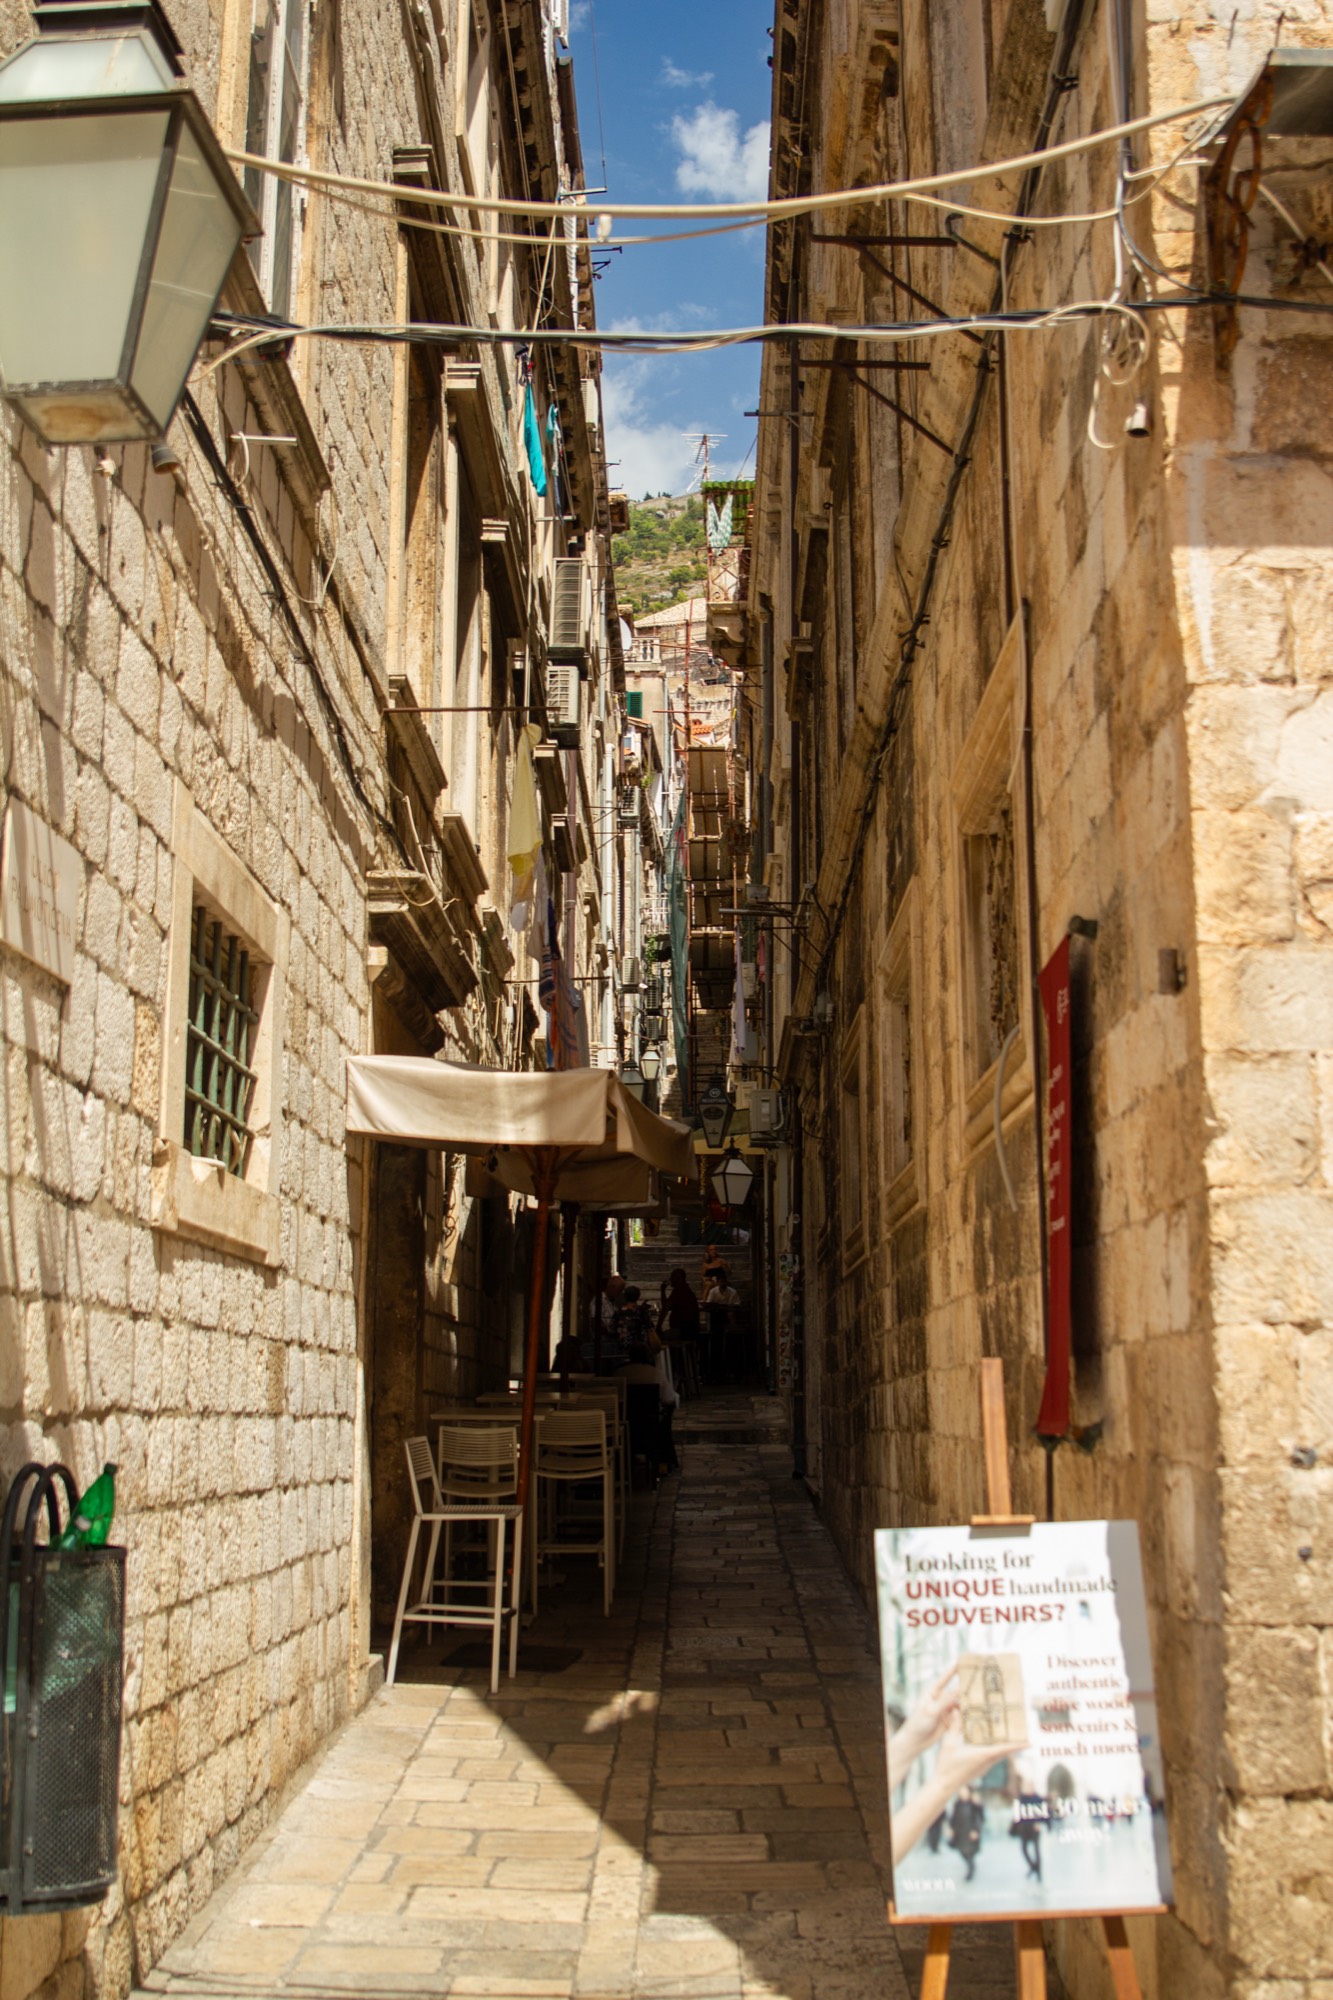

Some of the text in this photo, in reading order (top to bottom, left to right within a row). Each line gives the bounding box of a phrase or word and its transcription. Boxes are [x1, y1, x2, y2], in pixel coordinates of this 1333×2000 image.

[905, 1550, 1034, 1574] Looking for
[906, 1576, 1119, 1602] UNIQUE handmade
[906, 1604, 1065, 1628] SOUVENIRS?
[1046, 1653, 1117, 1669] Discover
[1046, 1675, 1121, 1690] authentic
[1042, 1696, 1080, 1712] olive
[1040, 1718, 1119, 1734] souvenirs
[1040, 1741, 1088, 1757] much
[1012, 1798, 1050, 1823] Just
